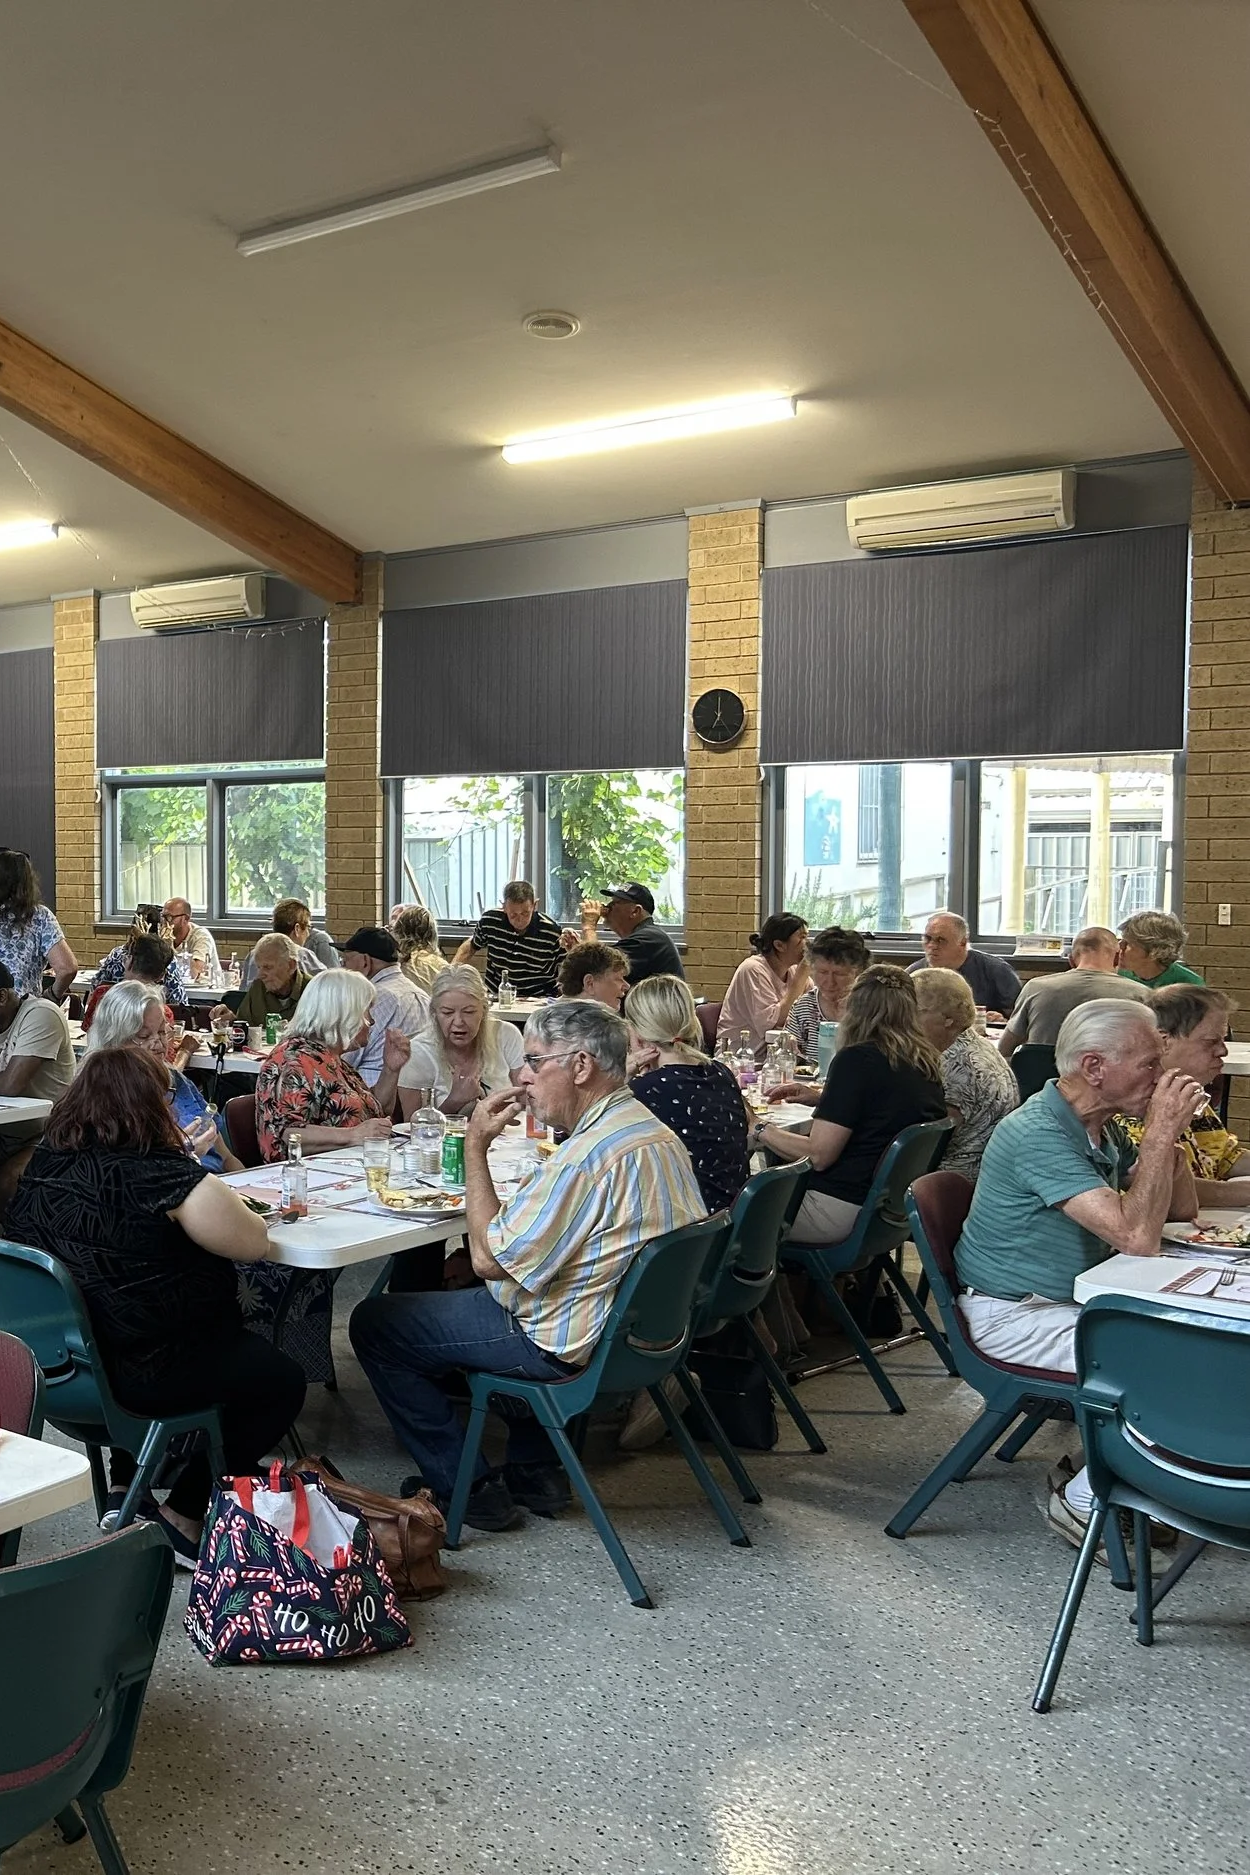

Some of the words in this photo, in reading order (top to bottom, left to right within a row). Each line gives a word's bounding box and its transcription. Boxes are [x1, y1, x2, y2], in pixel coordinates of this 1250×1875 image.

[274, 1602, 309, 1633] HO
[320, 1623, 350, 1649] HO
[353, 1595, 376, 1633] HO
